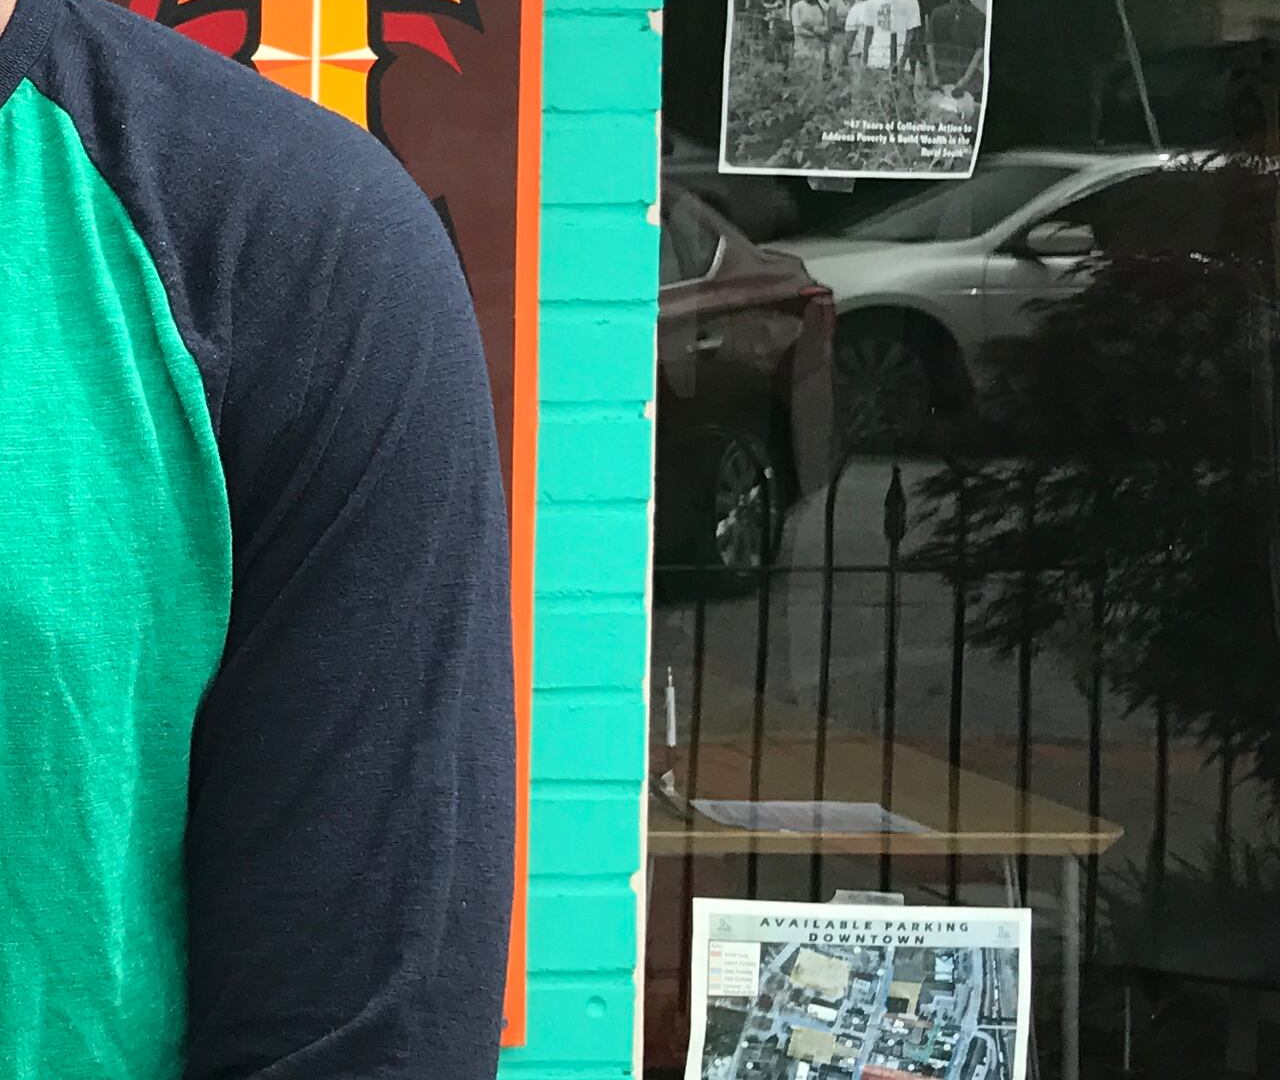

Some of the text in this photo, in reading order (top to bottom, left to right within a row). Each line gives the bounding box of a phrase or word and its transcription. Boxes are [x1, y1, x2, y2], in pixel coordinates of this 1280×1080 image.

[885, 121, 894, 131] of
[896, 121, 935, 132] Collective
[937, 123, 963, 133] Action
[822, 132, 855, 141] Address
[856, 132, 888, 144] Poverty
[897, 133, 919, 144] Build
[920, 134, 947, 145] Wealth
[958, 134, 970, 145] the
[759, 917, 970, 933] AVAILABLE PARKING
[808, 932, 926, 945] DOWNTOWN
